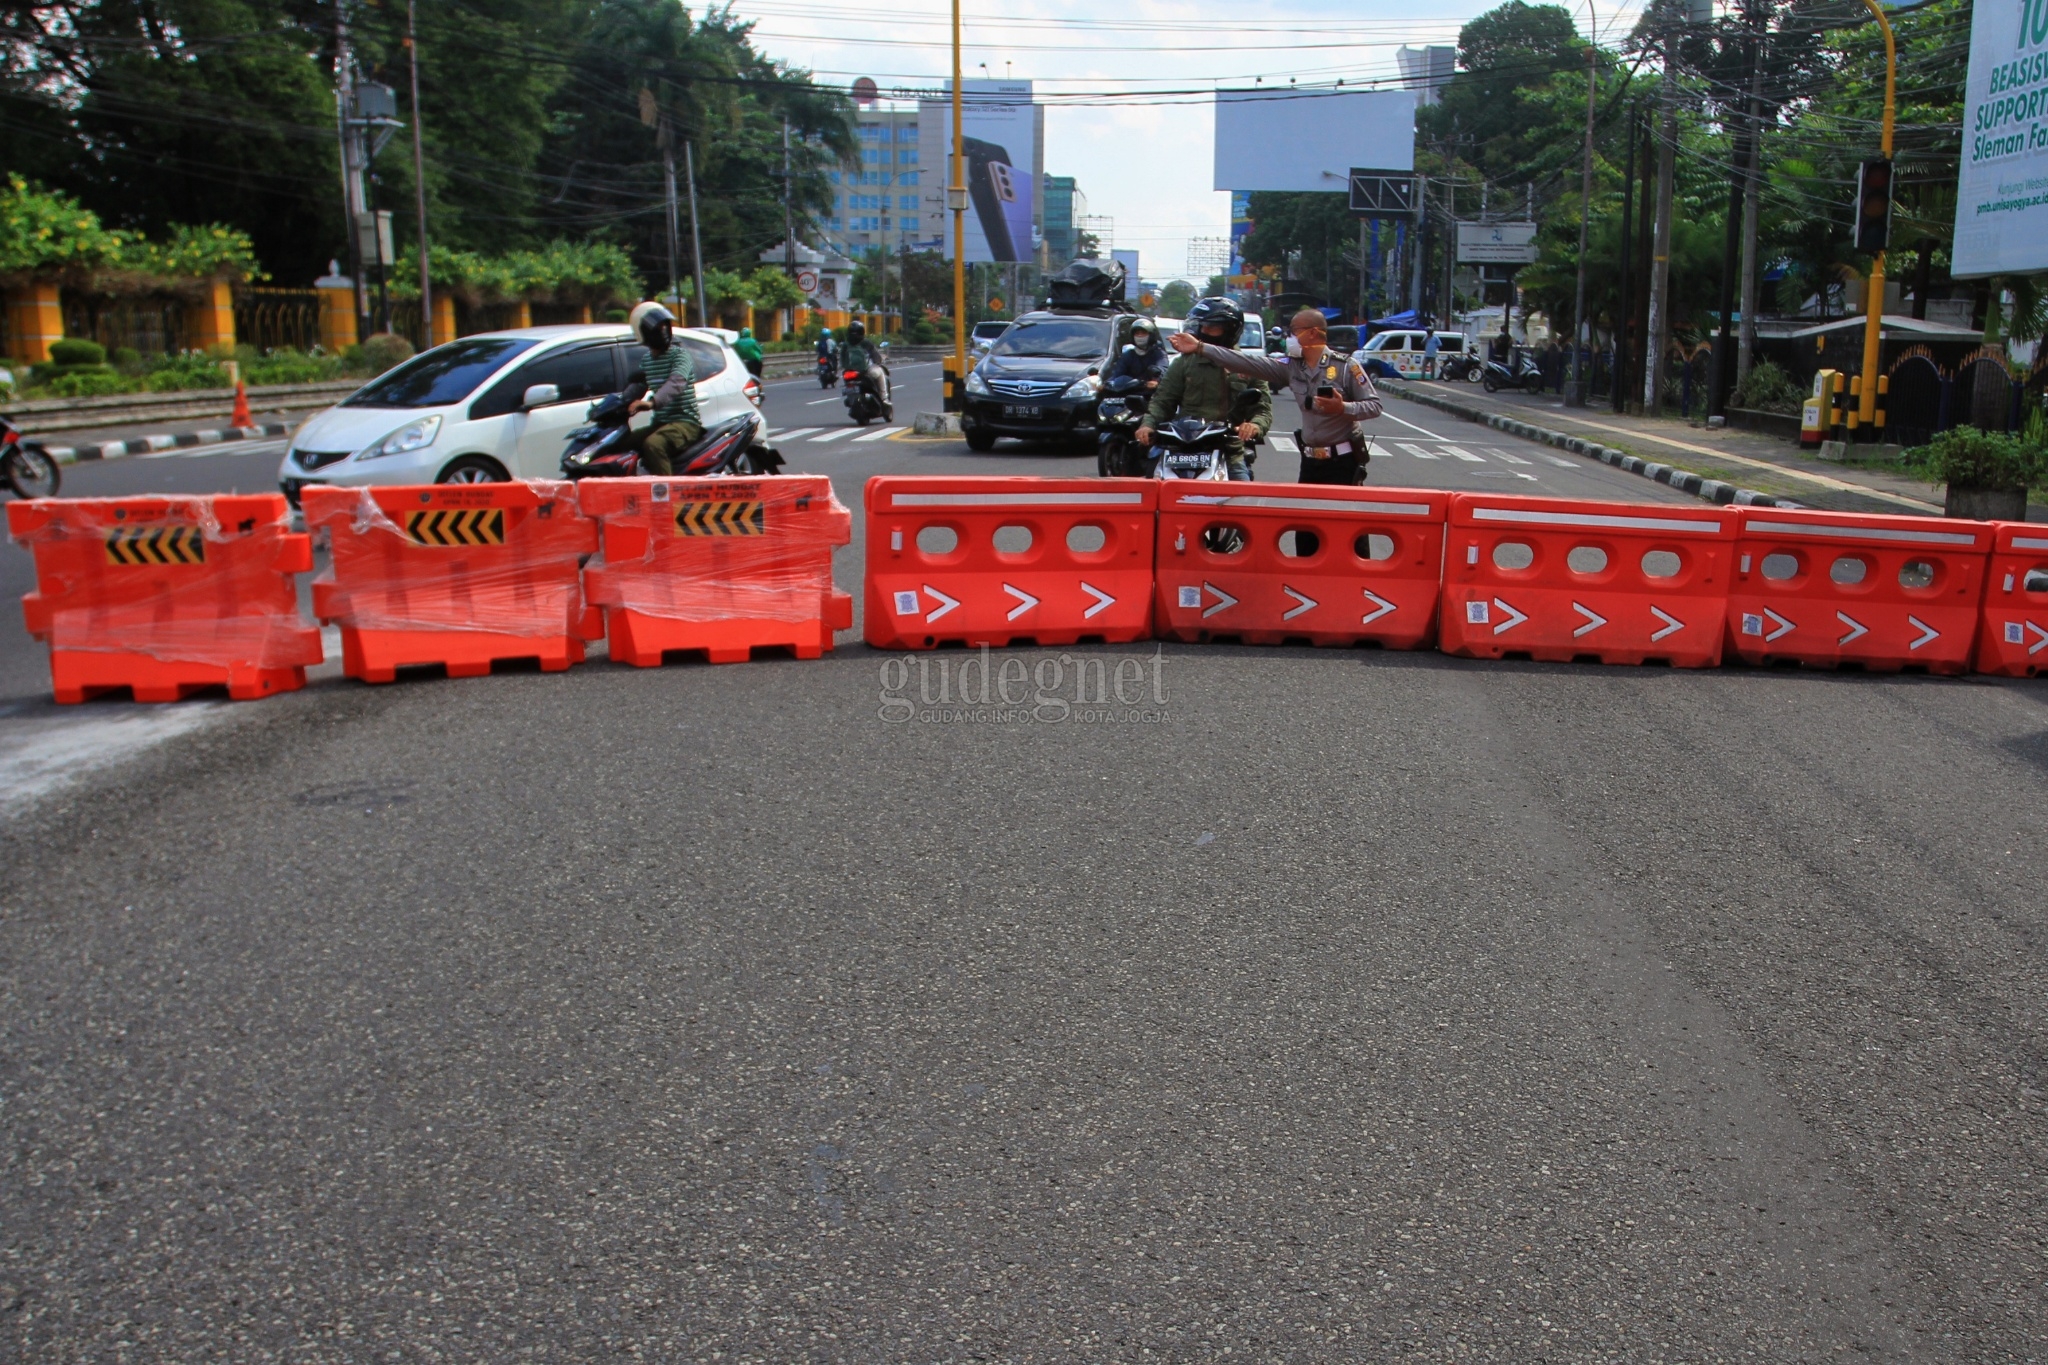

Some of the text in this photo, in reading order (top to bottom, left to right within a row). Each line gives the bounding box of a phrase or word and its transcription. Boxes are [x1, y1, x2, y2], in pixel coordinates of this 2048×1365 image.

[1973, 122, 2048, 161] Sleman Fa
[1167, 455, 1177, 463] AB
